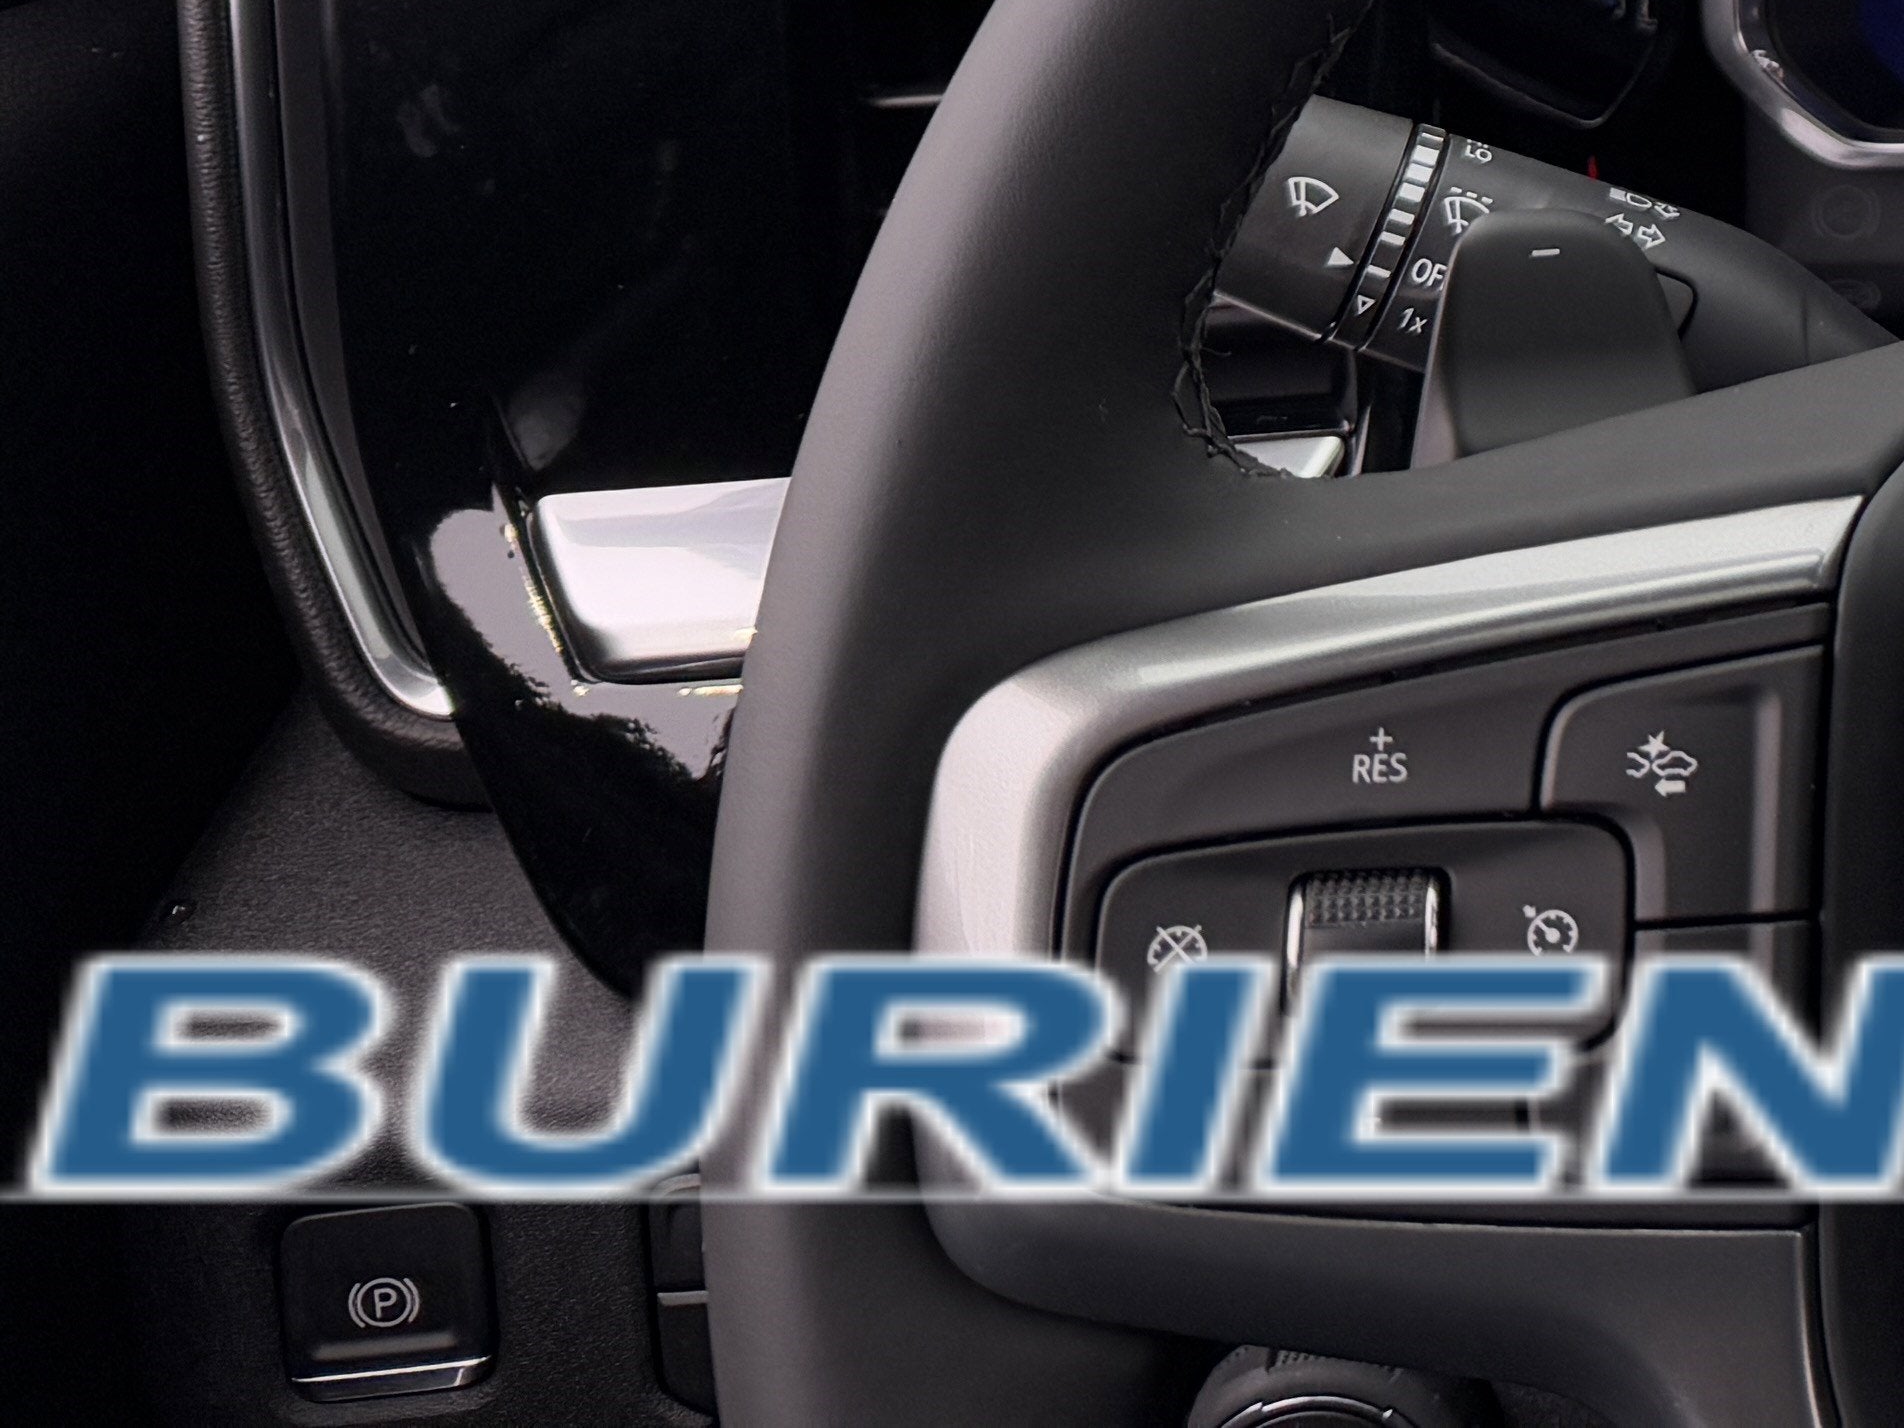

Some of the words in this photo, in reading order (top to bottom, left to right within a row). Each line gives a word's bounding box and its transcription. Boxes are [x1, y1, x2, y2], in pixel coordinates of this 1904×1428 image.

[1410, 257, 1447, 291] OF
[1399, 307, 1428, 334] 1x
[1352, 752, 1408, 784] RES
